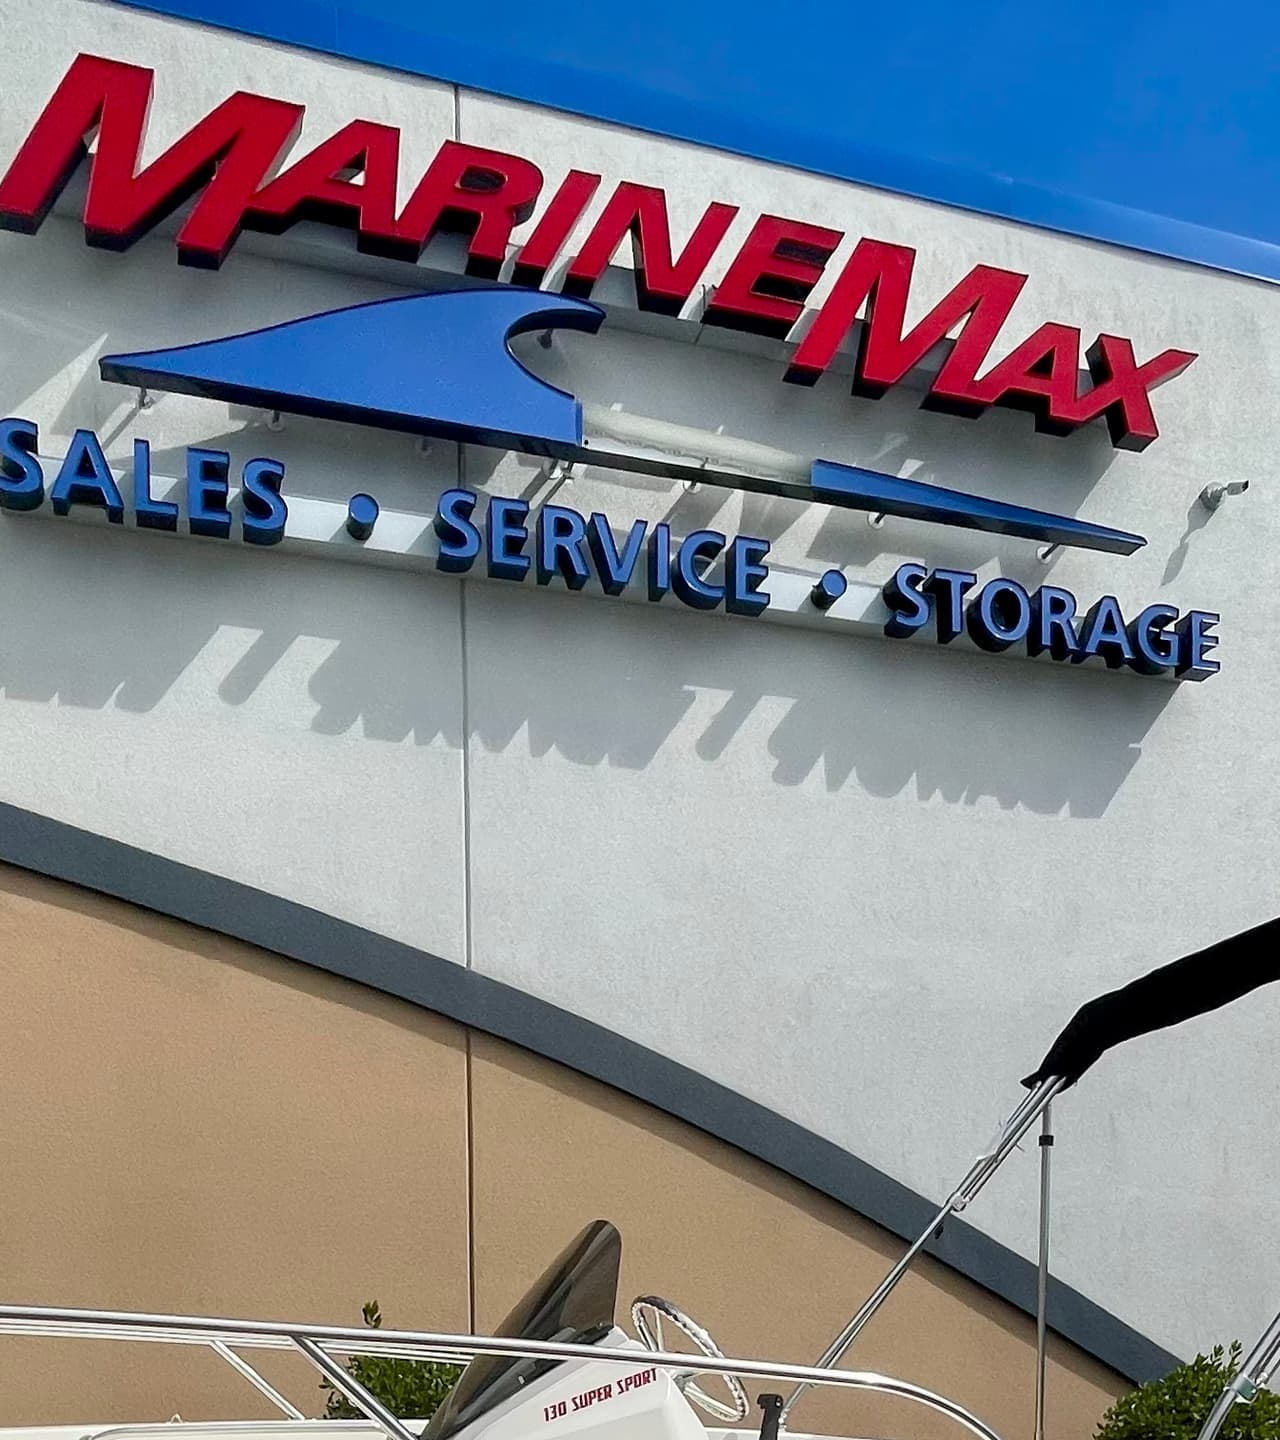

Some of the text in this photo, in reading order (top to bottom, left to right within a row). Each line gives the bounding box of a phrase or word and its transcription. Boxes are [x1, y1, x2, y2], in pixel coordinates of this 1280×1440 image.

[434, 490, 771, 611] SERVICE
[883, 564, 1222, 681] STORAGE
[543, 1367, 657, 1422] 130 SUPER SPORT
